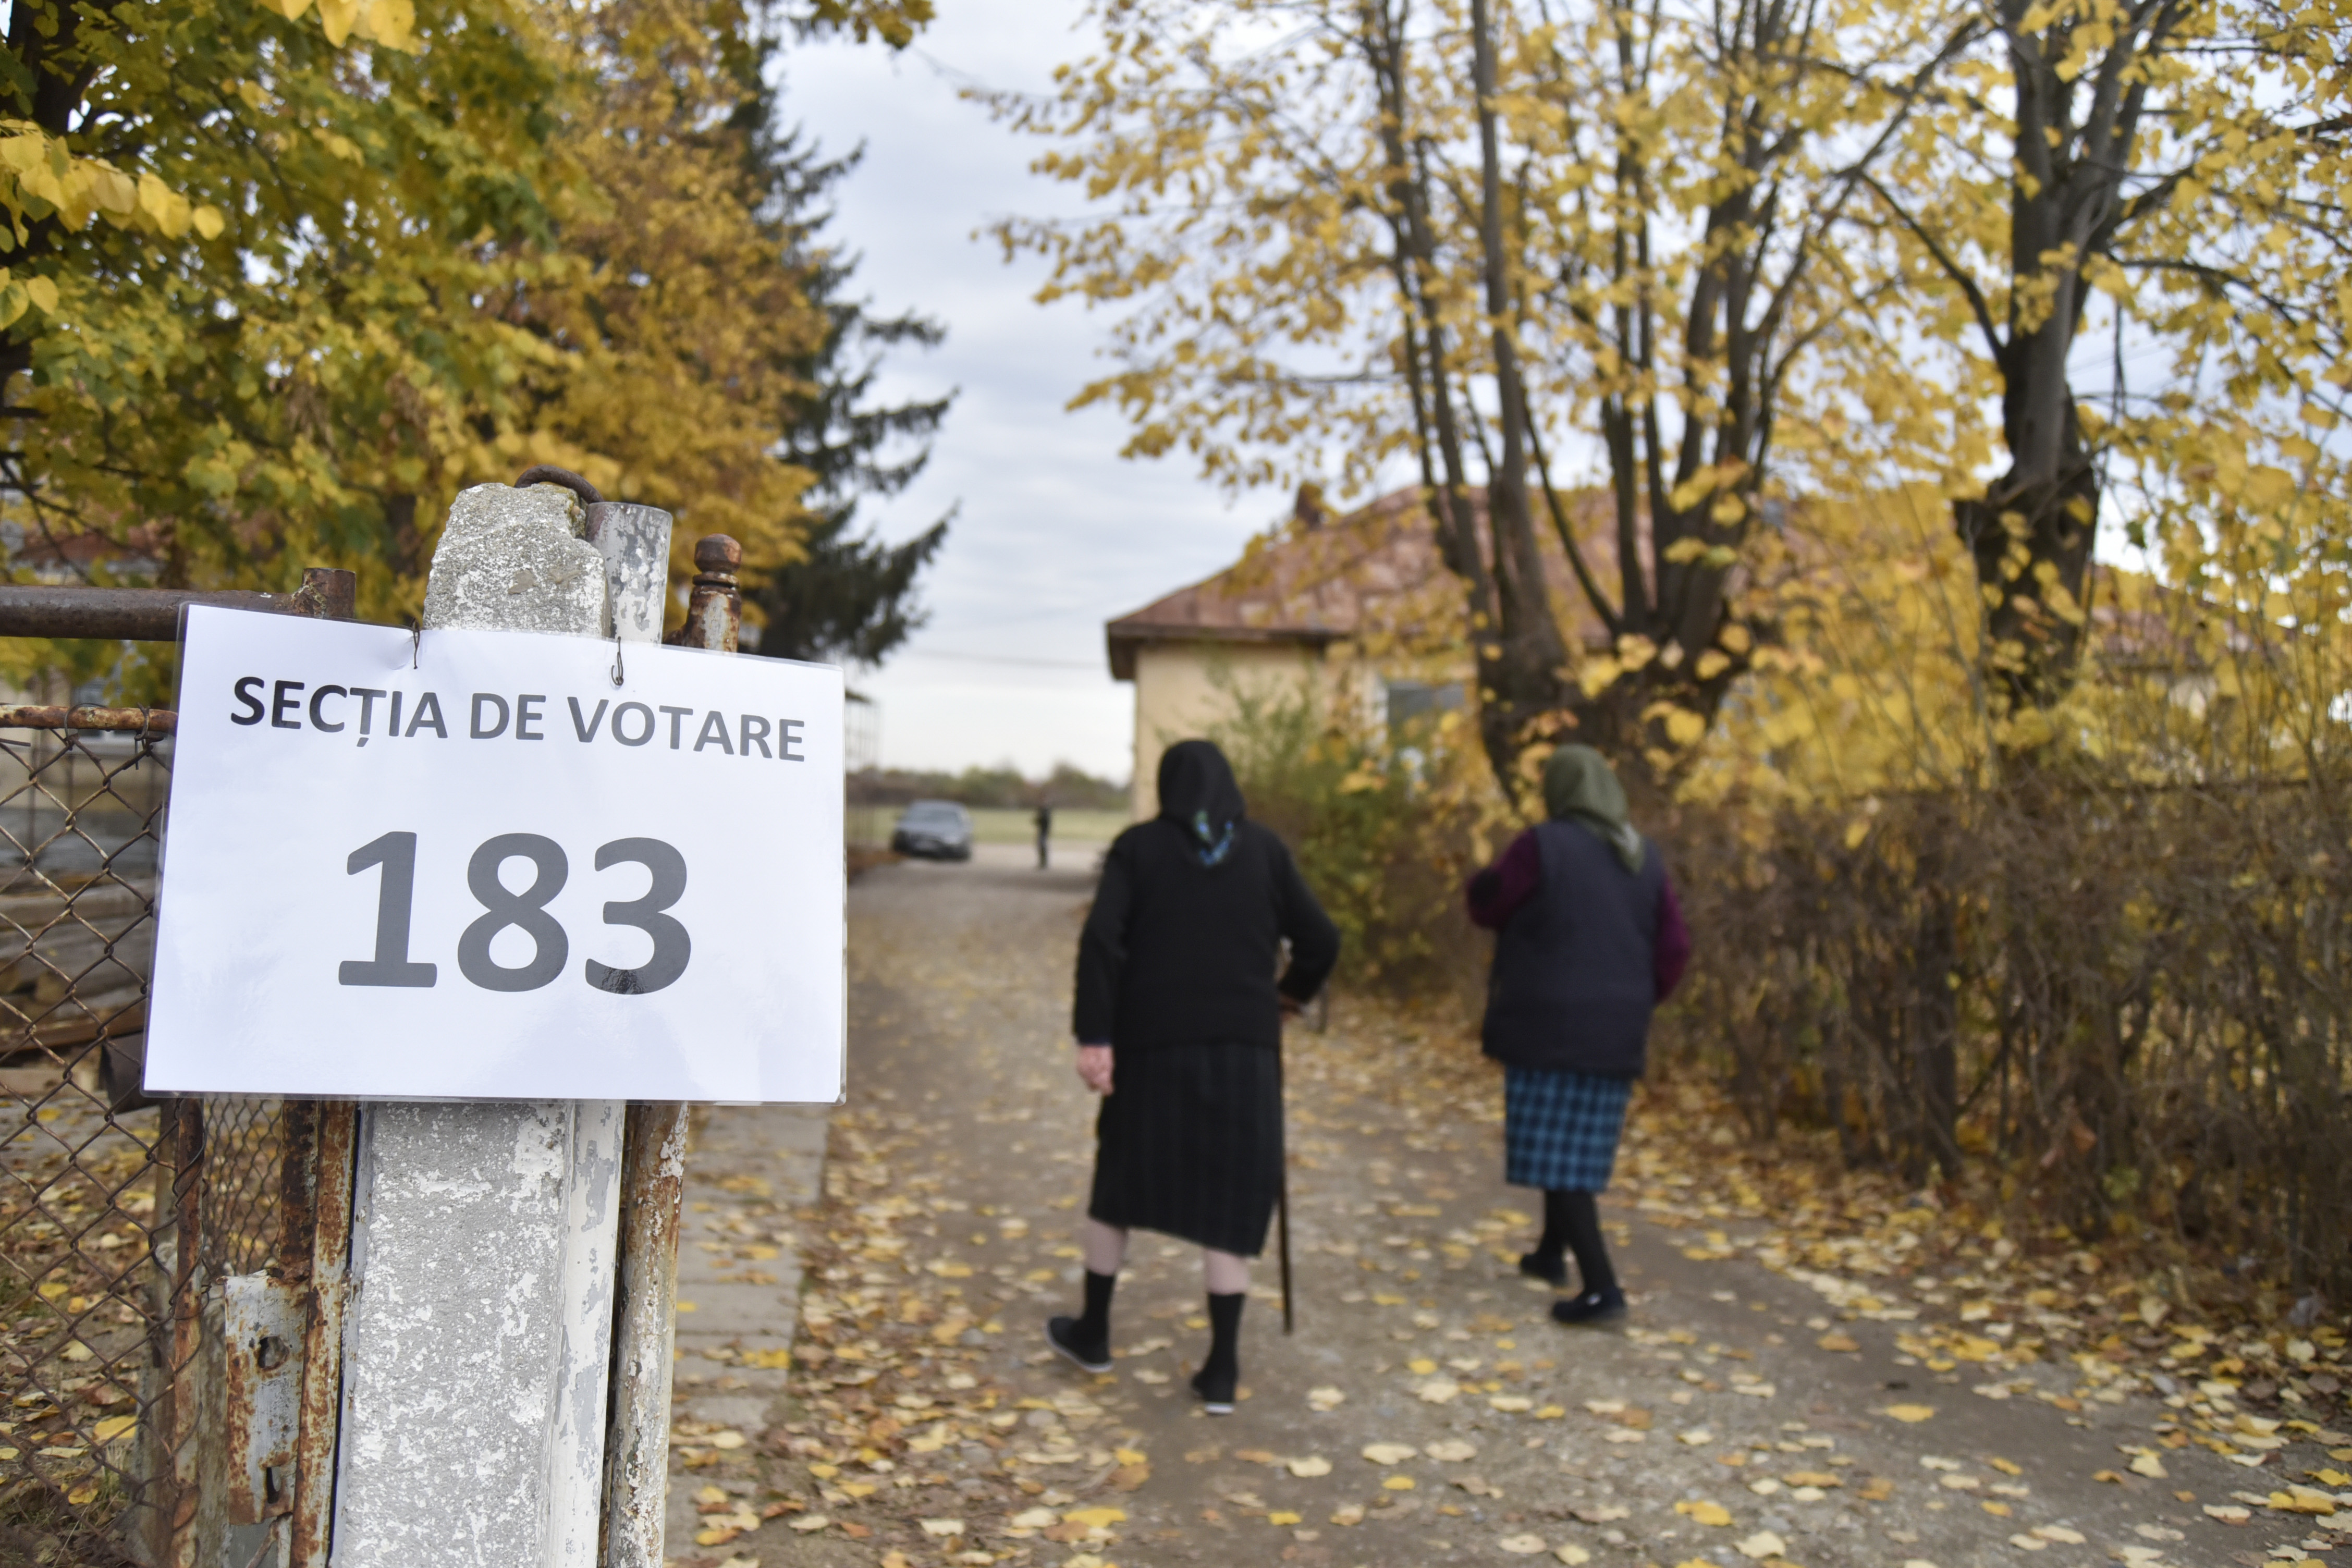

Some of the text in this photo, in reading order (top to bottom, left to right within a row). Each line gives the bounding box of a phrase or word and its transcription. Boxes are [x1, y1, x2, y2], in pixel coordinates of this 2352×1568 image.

[230, 676, 805, 762] SECȚIA DE VOTARE
[337, 830, 692, 996] 183
